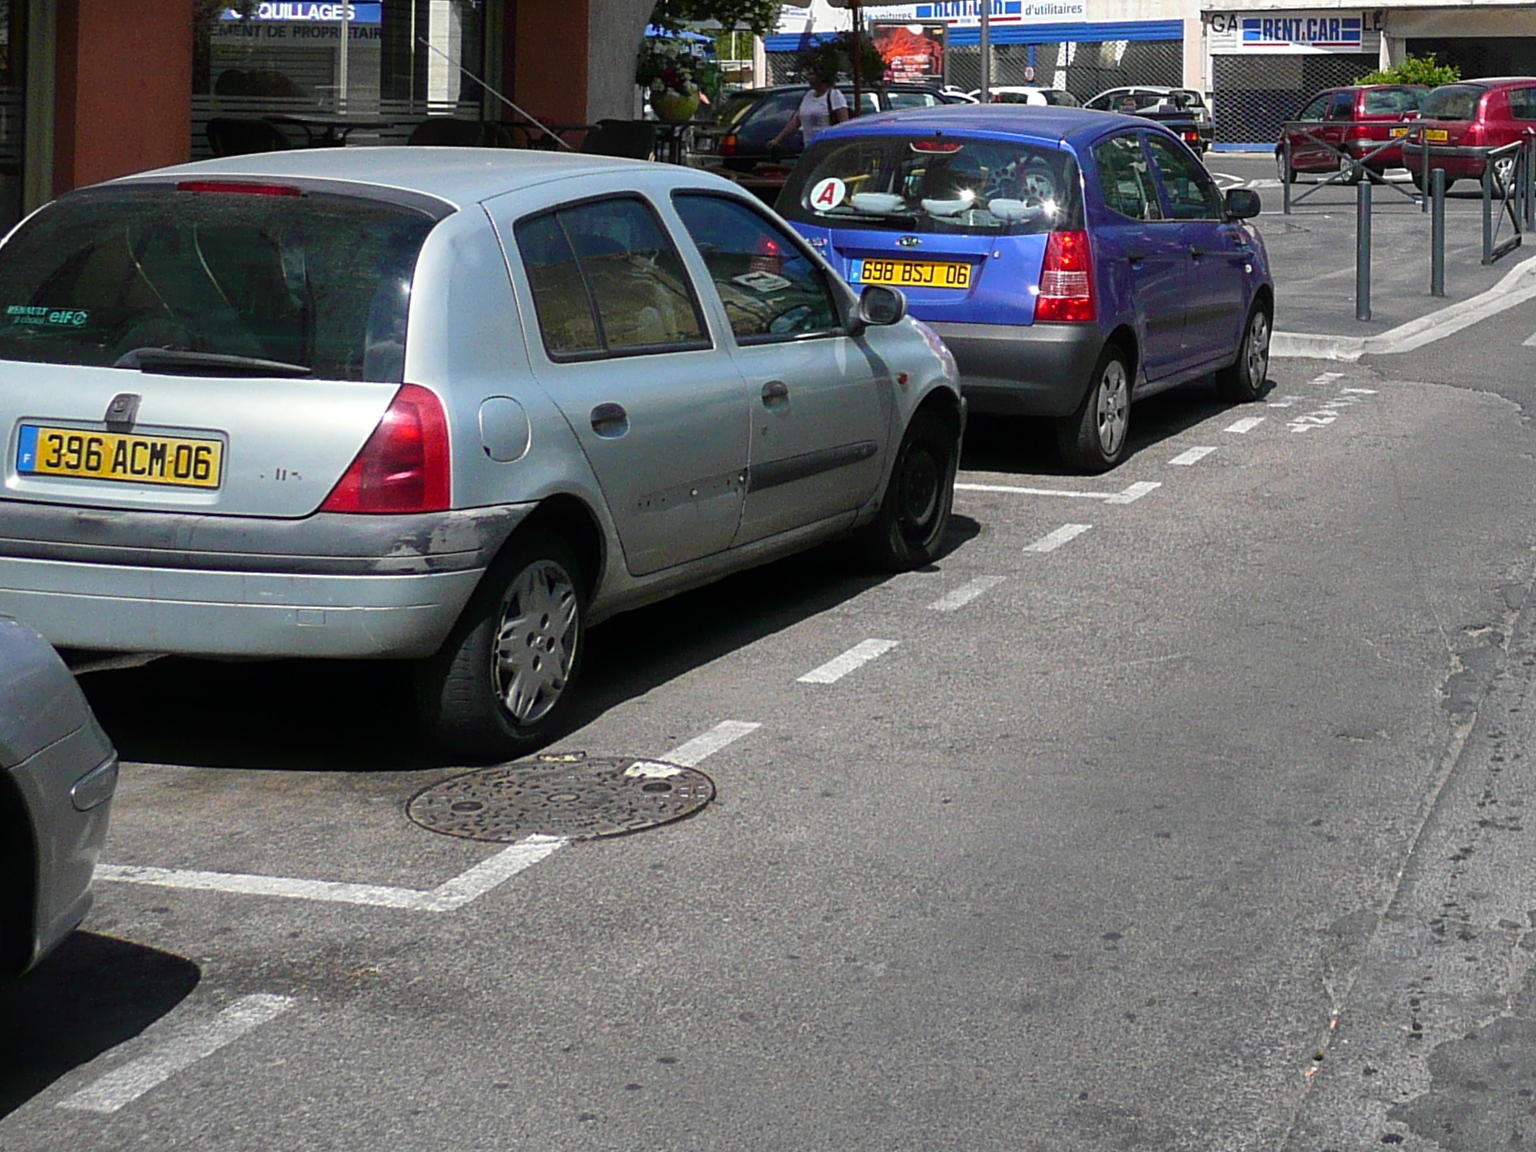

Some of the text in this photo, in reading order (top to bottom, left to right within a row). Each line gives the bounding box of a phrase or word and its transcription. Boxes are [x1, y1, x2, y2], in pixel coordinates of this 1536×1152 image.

[1025, 1, 1083, 16] d'utilitaires
[267, 25, 286, 38] DE
[1263, 18, 1303, 41] RENT
[1307, 18, 1341, 41] CAR
[817, 182, 836, 206] A
[862, 261, 894, 282] 698
[901, 263, 935, 283] BSJ
[946, 265, 968, 285] 06
[50, 311, 74, 324] elf
[23, 434, 213, 481] F 396 ACM 06
